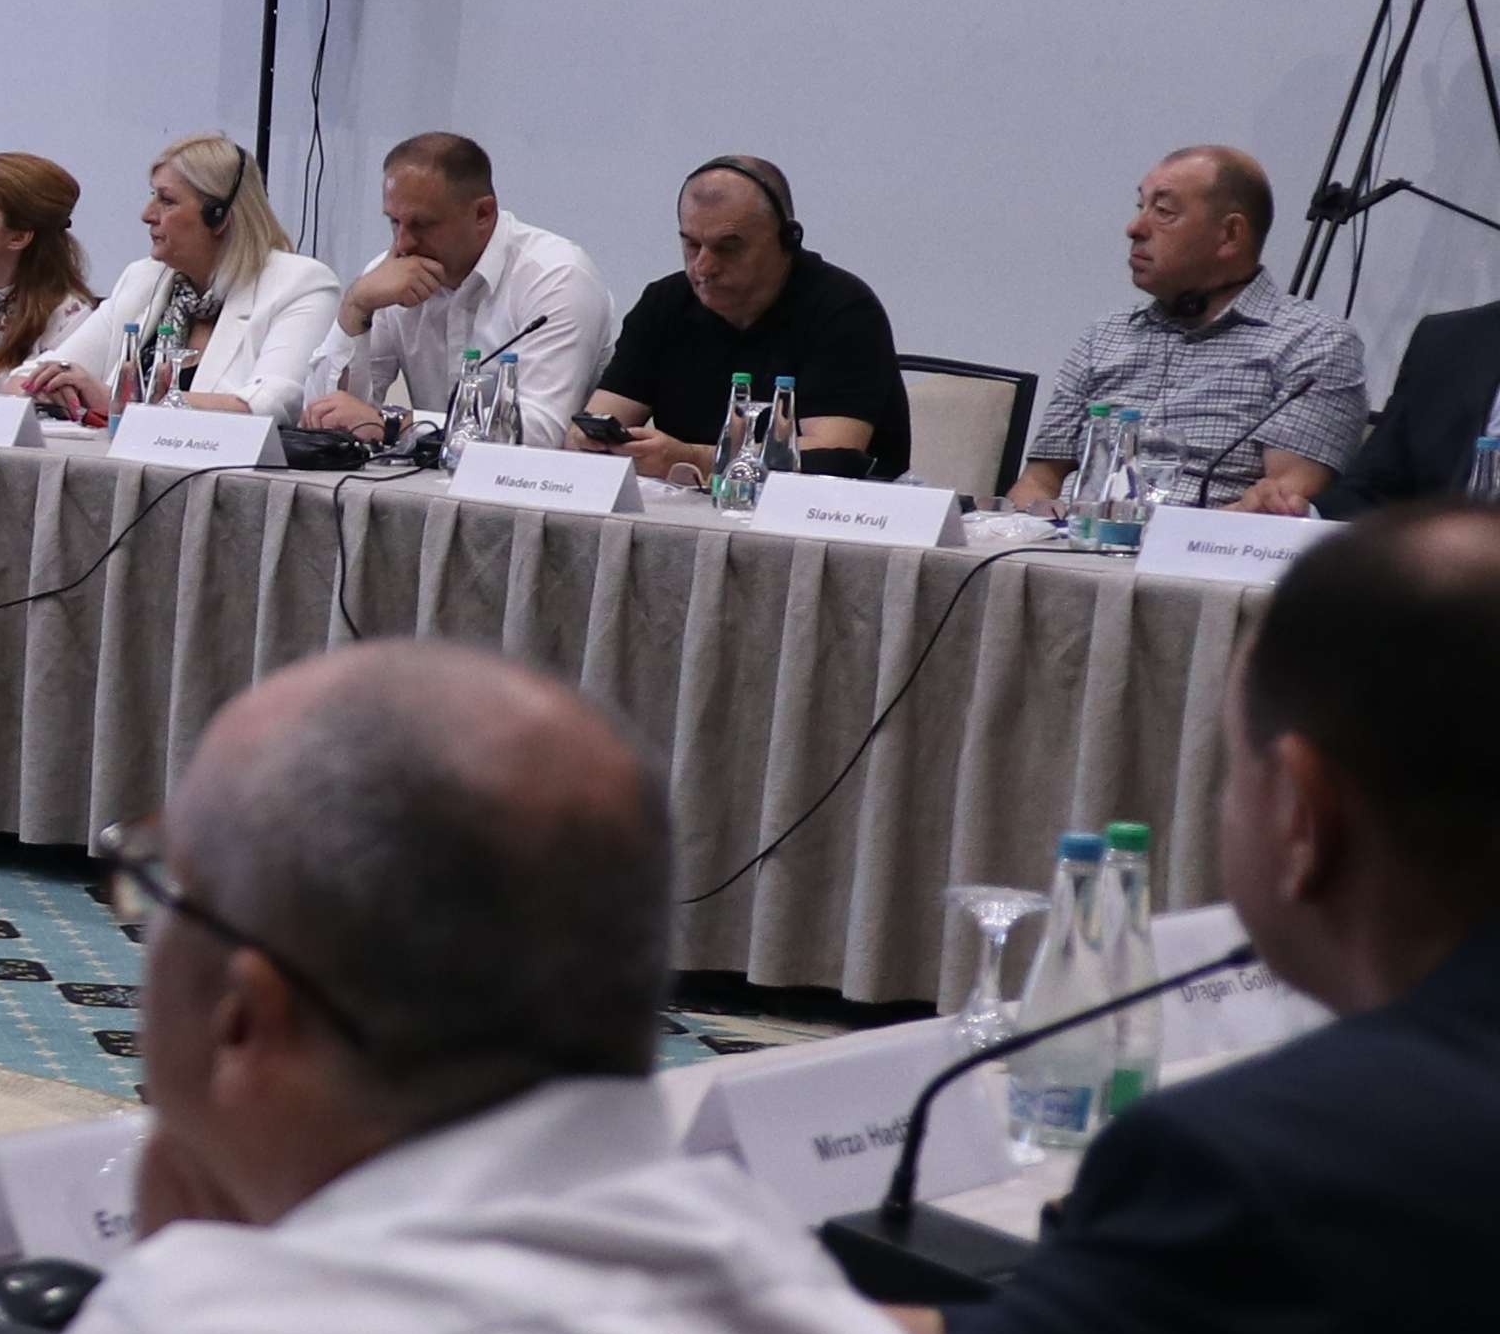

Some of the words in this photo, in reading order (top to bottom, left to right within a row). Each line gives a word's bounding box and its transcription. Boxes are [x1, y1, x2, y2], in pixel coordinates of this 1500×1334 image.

[153, 435, 184, 450] Josip
[184, 438, 221, 452] Aničić
[494, 475, 538, 490] Mladen
[539, 479, 575, 495] Simić
[806, 508, 852, 524] Slavko
[854, 513, 888, 530] Krulj
[1186, 540, 1240, 557] Milimir
[1242, 545, 1301, 562] Pojužin
[813, 1129, 866, 1163] Mirza
